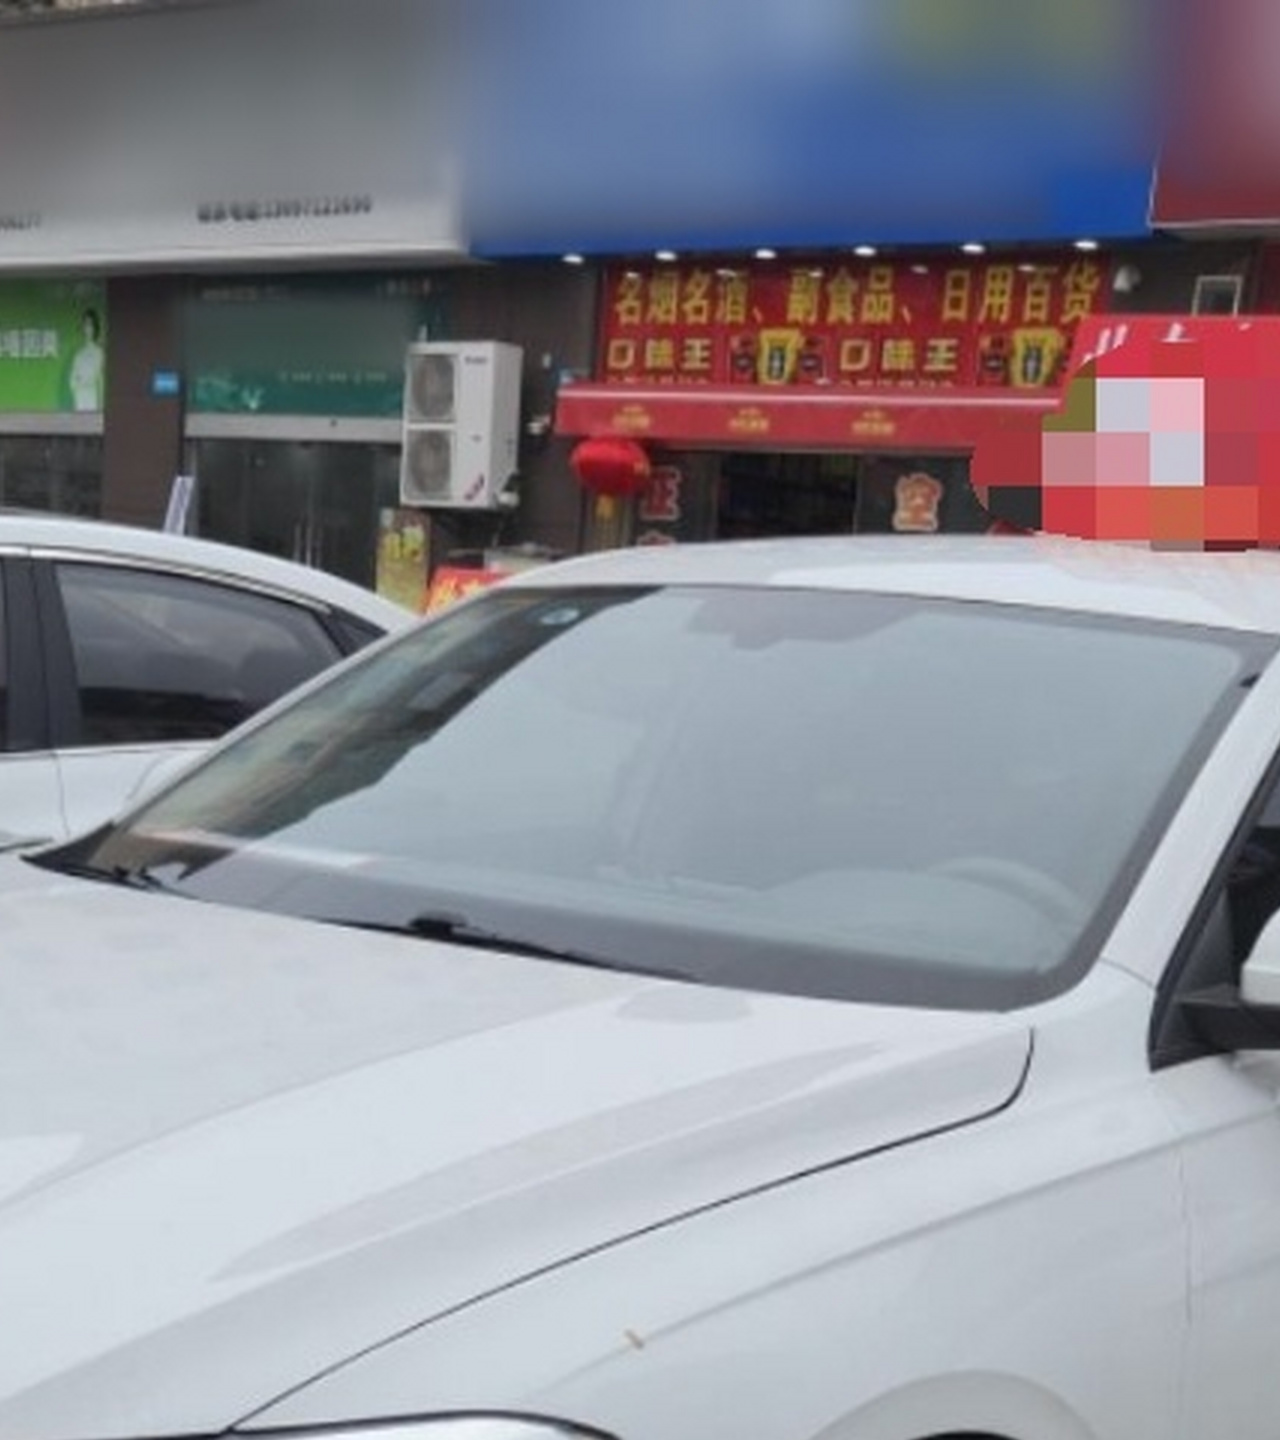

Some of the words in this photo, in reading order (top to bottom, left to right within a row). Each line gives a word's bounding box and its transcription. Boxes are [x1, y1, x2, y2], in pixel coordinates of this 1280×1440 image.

[608, 338, 711, 370] 口味王
[840, 338, 959, 371] 口味王
